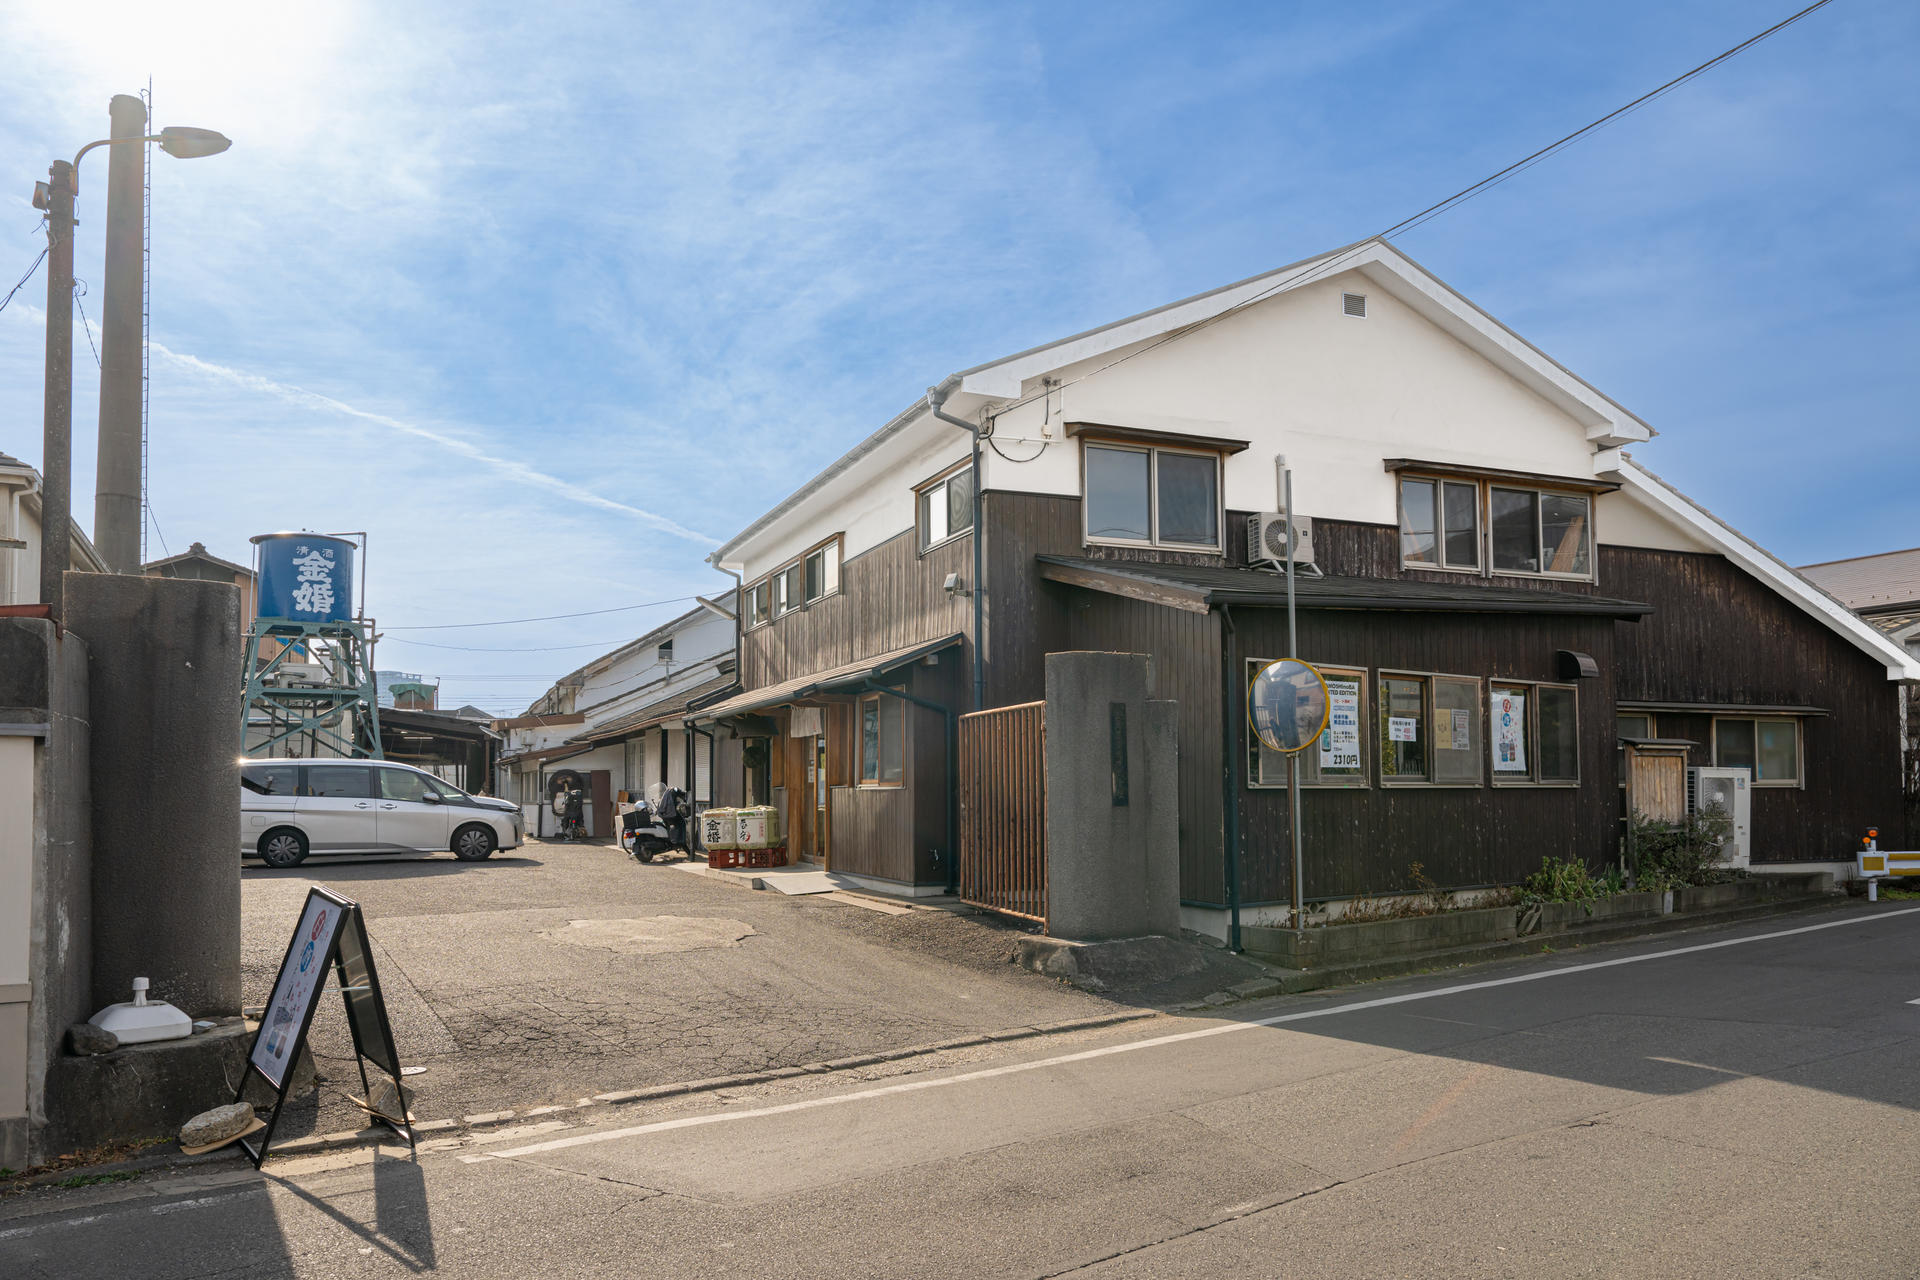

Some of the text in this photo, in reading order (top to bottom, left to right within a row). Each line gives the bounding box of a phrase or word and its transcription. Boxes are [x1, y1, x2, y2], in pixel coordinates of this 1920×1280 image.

[296, 546, 334, 558] 清酒
[292, 551, 335, 613] 金婚
[1334, 754, 1358, 765] 2310円
[707, 819, 721, 843] 金婚
